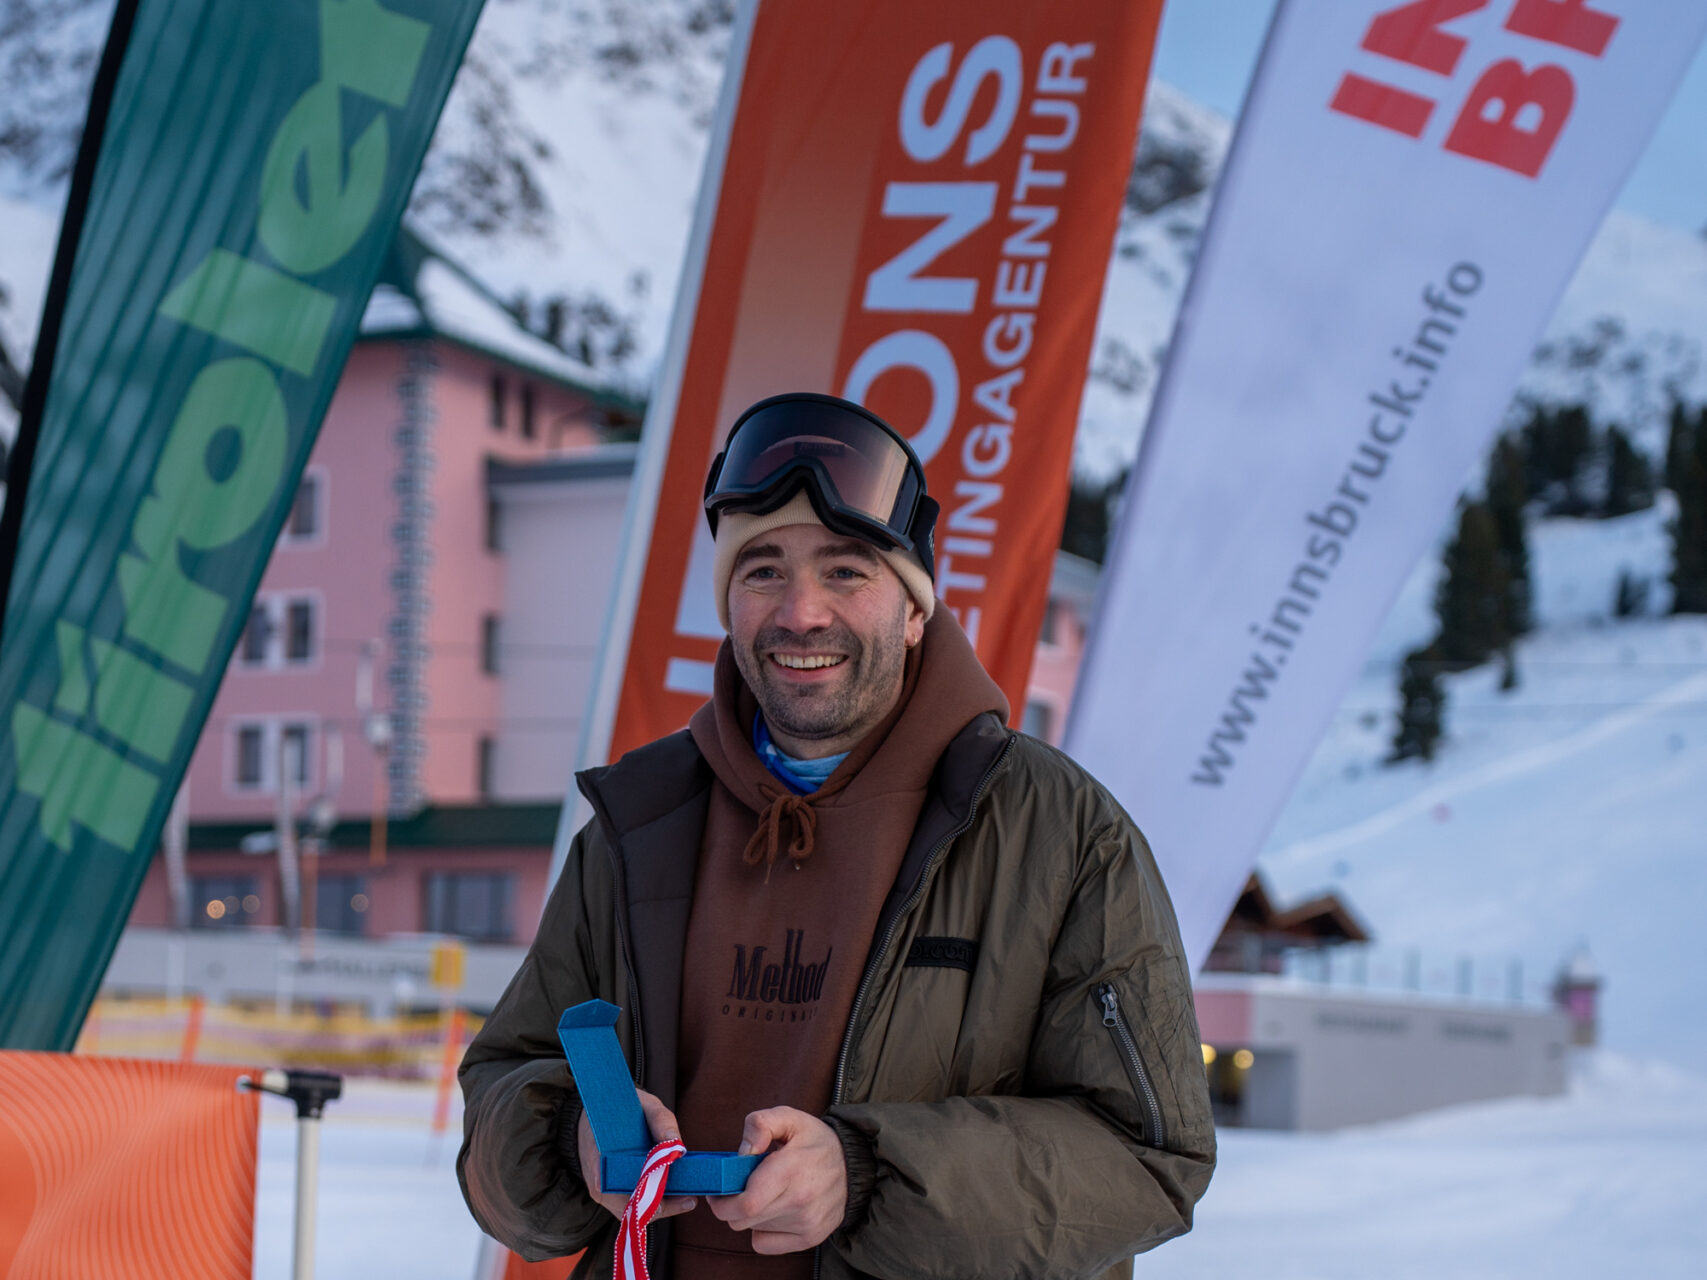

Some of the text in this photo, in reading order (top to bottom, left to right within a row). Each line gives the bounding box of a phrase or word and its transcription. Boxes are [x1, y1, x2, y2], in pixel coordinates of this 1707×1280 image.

[10, 0, 433, 853] tiroler
[843, 34, 1023, 469] ONS
[1190, 258, 1486, 790] www.innsbruck.info
[726, 928, 833, 1004] Method
